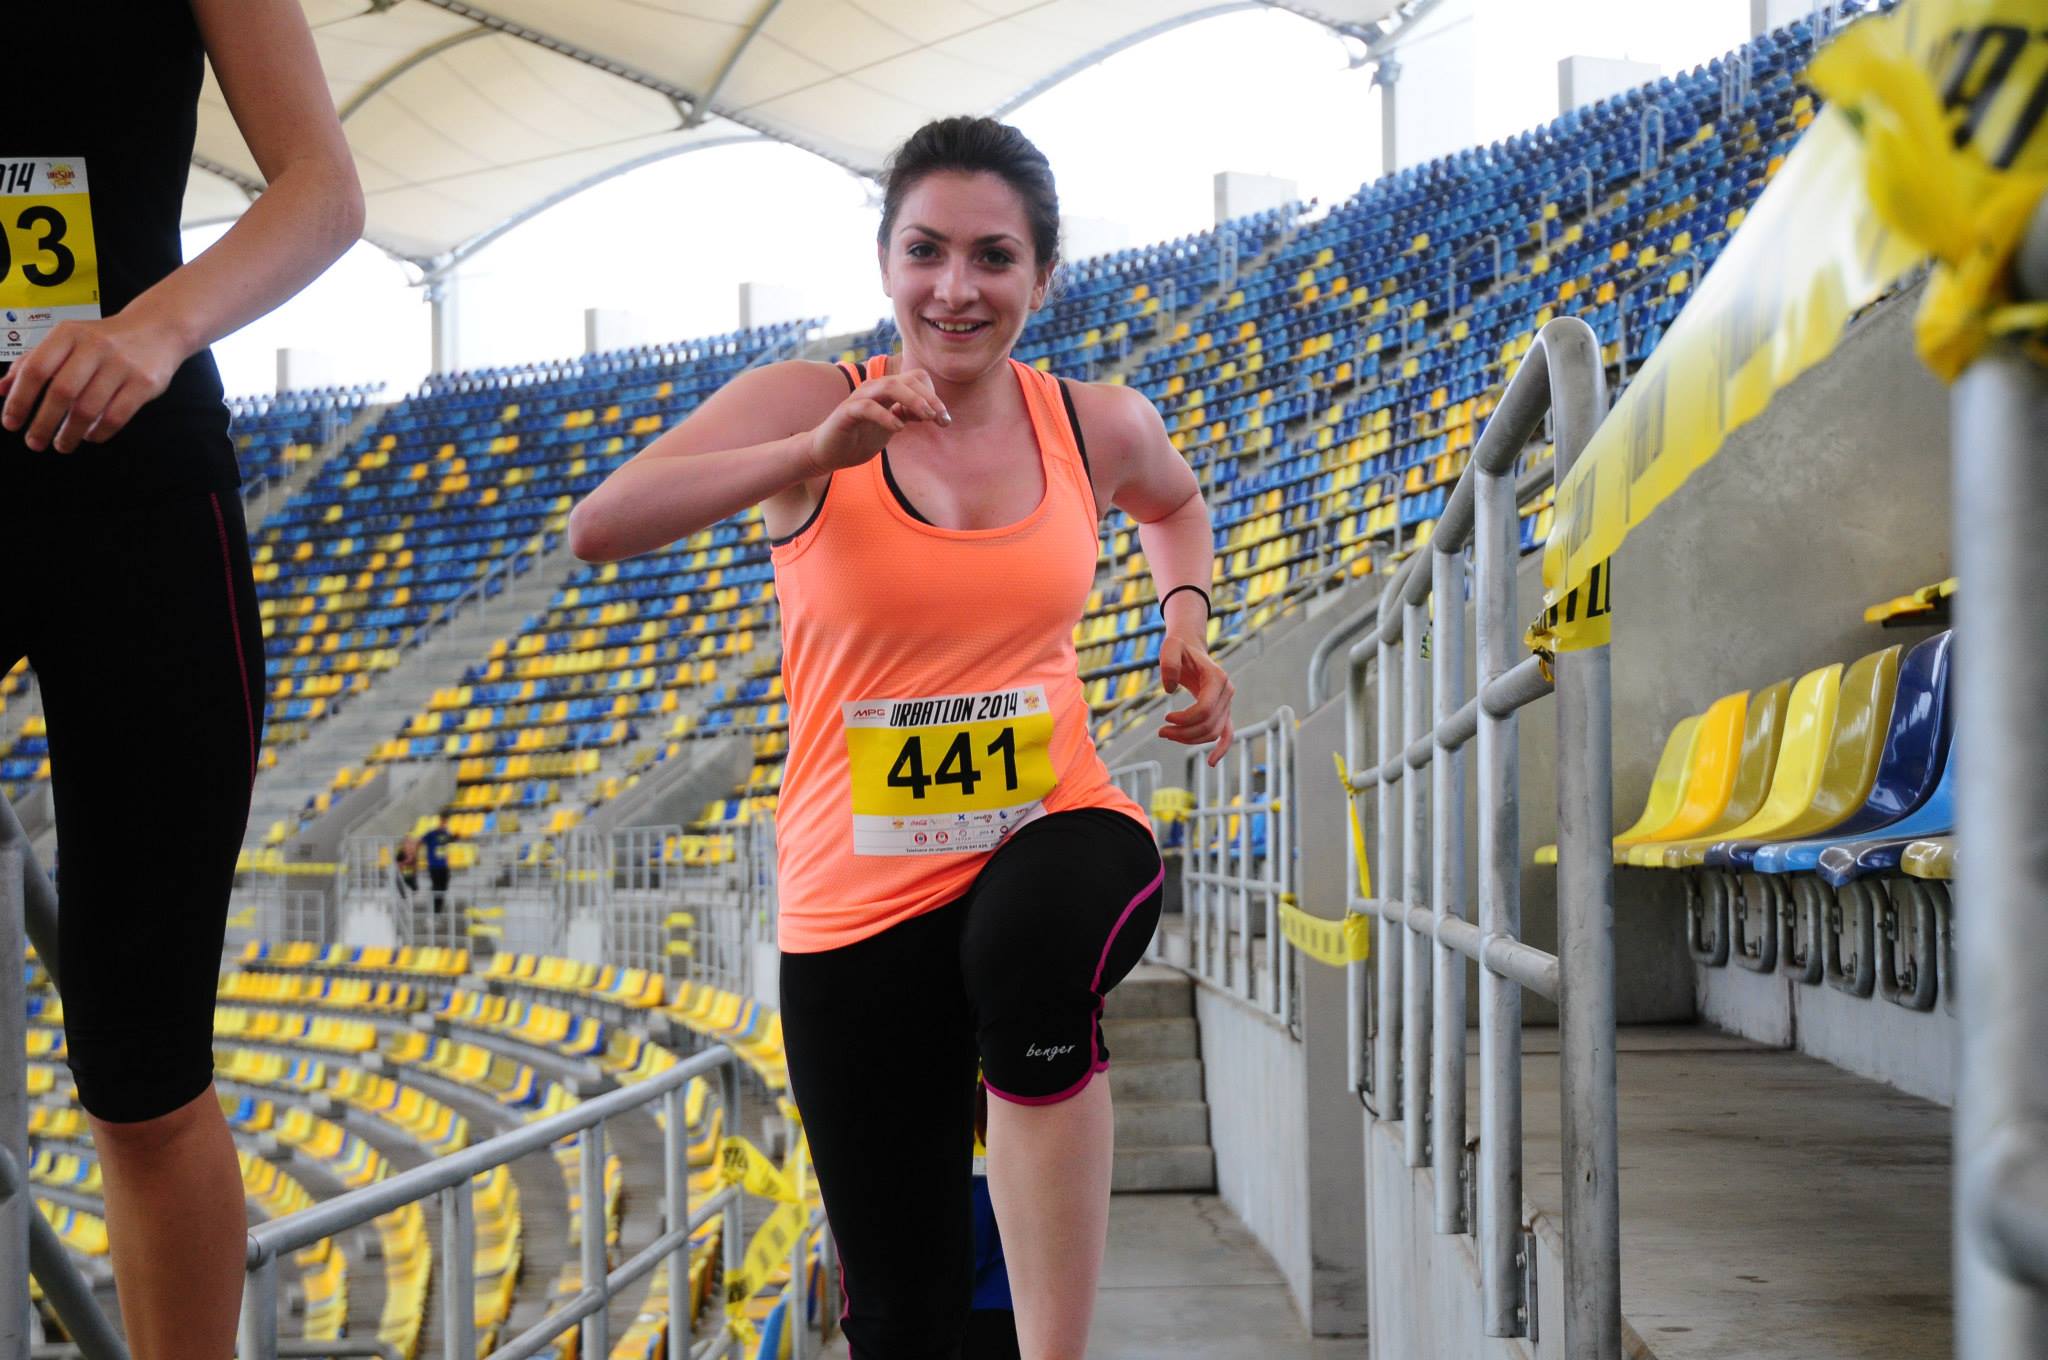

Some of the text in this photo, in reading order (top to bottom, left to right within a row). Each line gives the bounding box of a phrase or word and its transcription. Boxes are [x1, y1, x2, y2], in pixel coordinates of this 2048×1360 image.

[889, 692, 1018, 727] URBATLON 2014
[887, 726, 1018, 800] 441
[1026, 1043, 1076, 1062] benger
